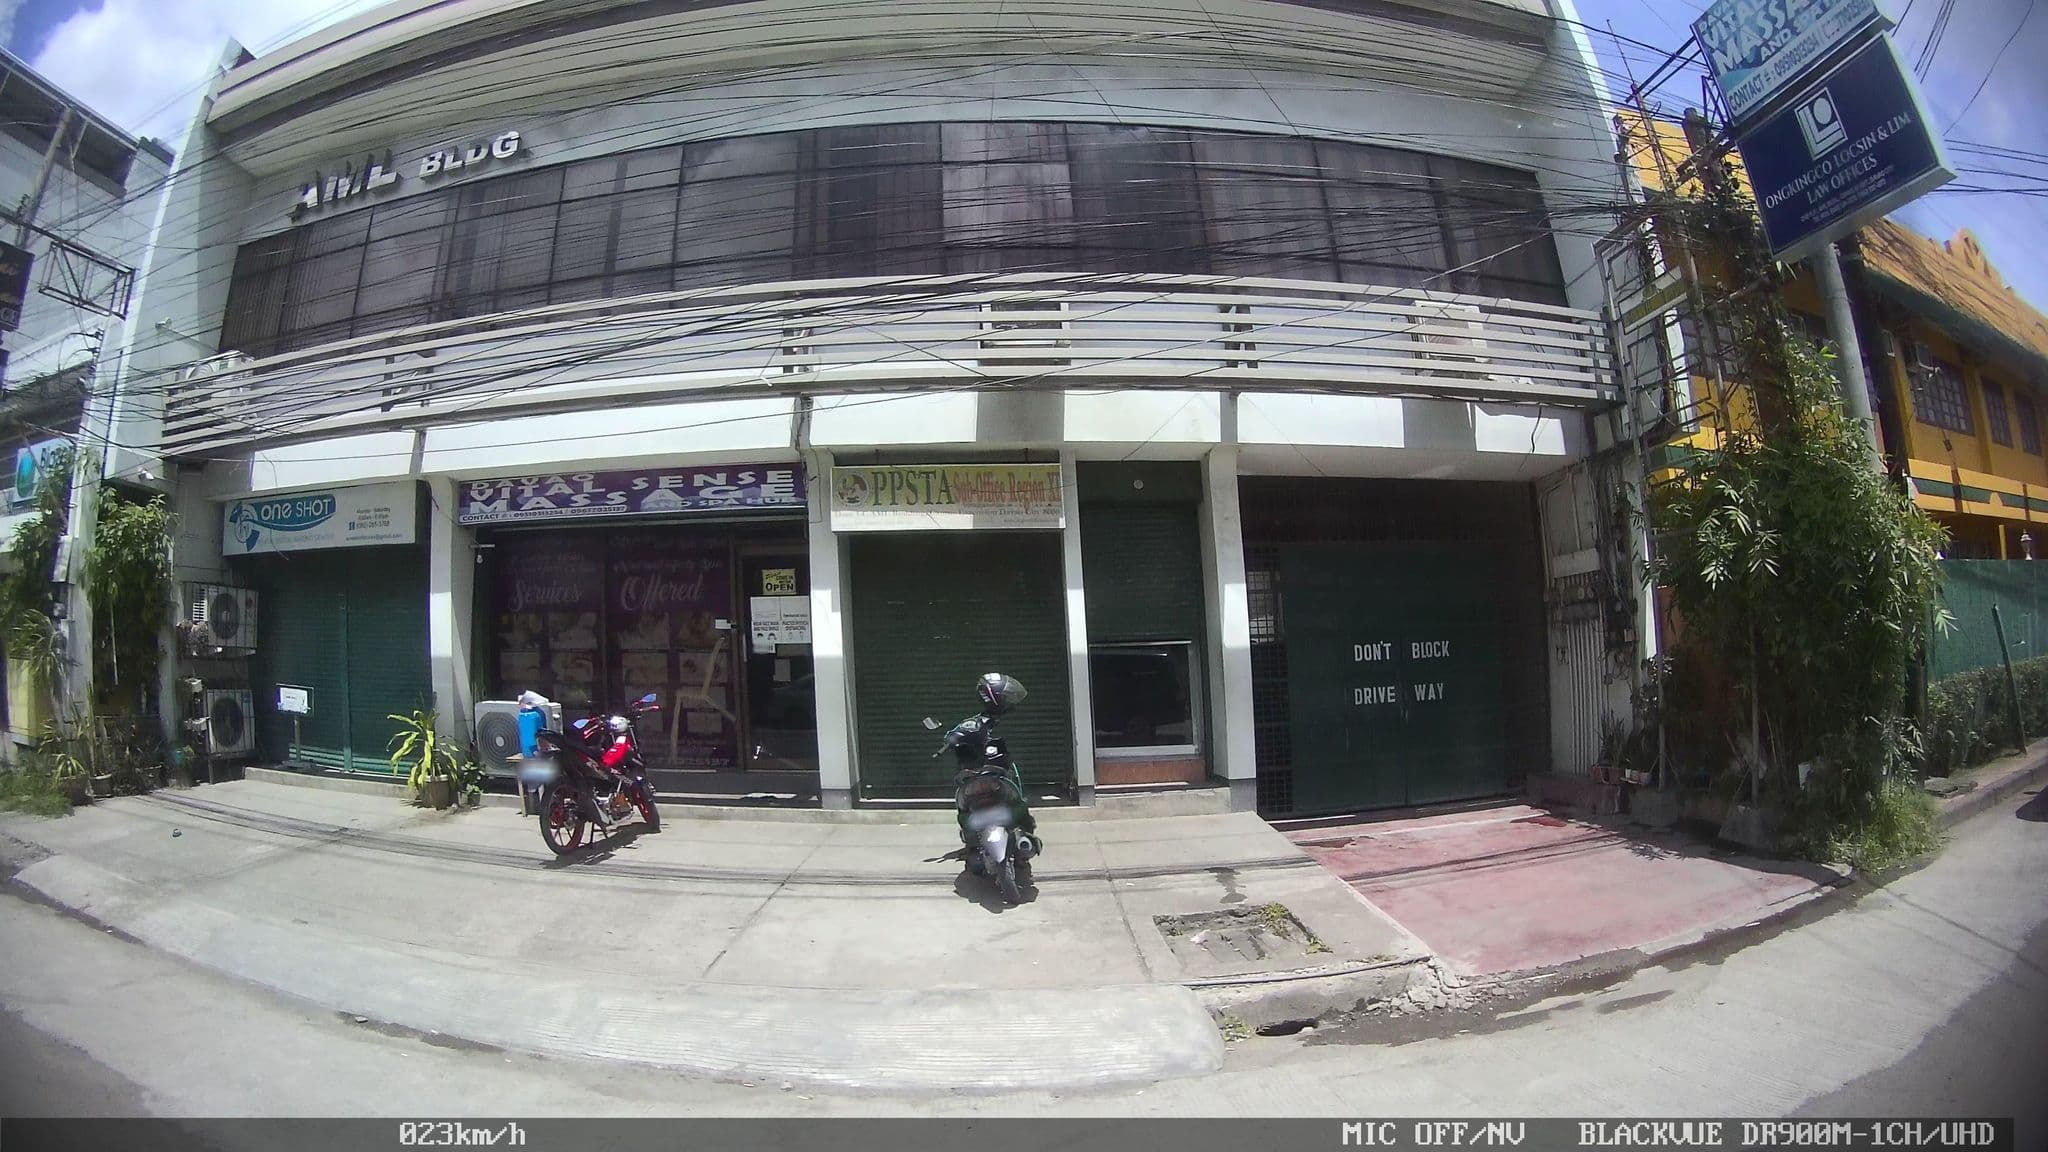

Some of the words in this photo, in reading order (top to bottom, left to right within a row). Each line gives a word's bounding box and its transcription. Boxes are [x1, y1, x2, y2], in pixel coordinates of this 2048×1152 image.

[1760, 28, 1792, 61] AND
[1729, 73, 1764, 111] CONTACT
[419, 131, 521, 178] BLDG
[1765, 160, 1832, 209] ONGKINGCO
[1834, 131, 1878, 168] LOCSIN
[1877, 126, 1889, 141] &
[1887, 112, 1912, 135] LIM
[1807, 184, 1831, 204] LAW
[1830, 153, 1878, 190] OFFICES
[469, 481, 606, 501] VITAL
[631, 470, 794, 490] SENSE
[472, 473, 595, 490] DAVAO
[871, 469, 955, 506] PPSTA
[953, 471, 1005, 503] Sub-Office
[1008, 471, 1045, 514] Region
[261, 502, 292, 521] one
[296, 499, 331, 517] SHOT
[470, 483, 796, 515] MASSAGE
[699, 497, 740, 506] SPA
[462, 513, 499, 522] CONTACT
[510, 579, 583, 612] Services
[620, 573, 704, 611] Offered
[765, 582, 794, 592] OPEN
[1354, 641, 1392, 661] DON'T
[1412, 640, 1450, 659] BLOCK
[1354, 686, 1396, 705] DRIVE
[1414, 683, 1444, 702] WAY
